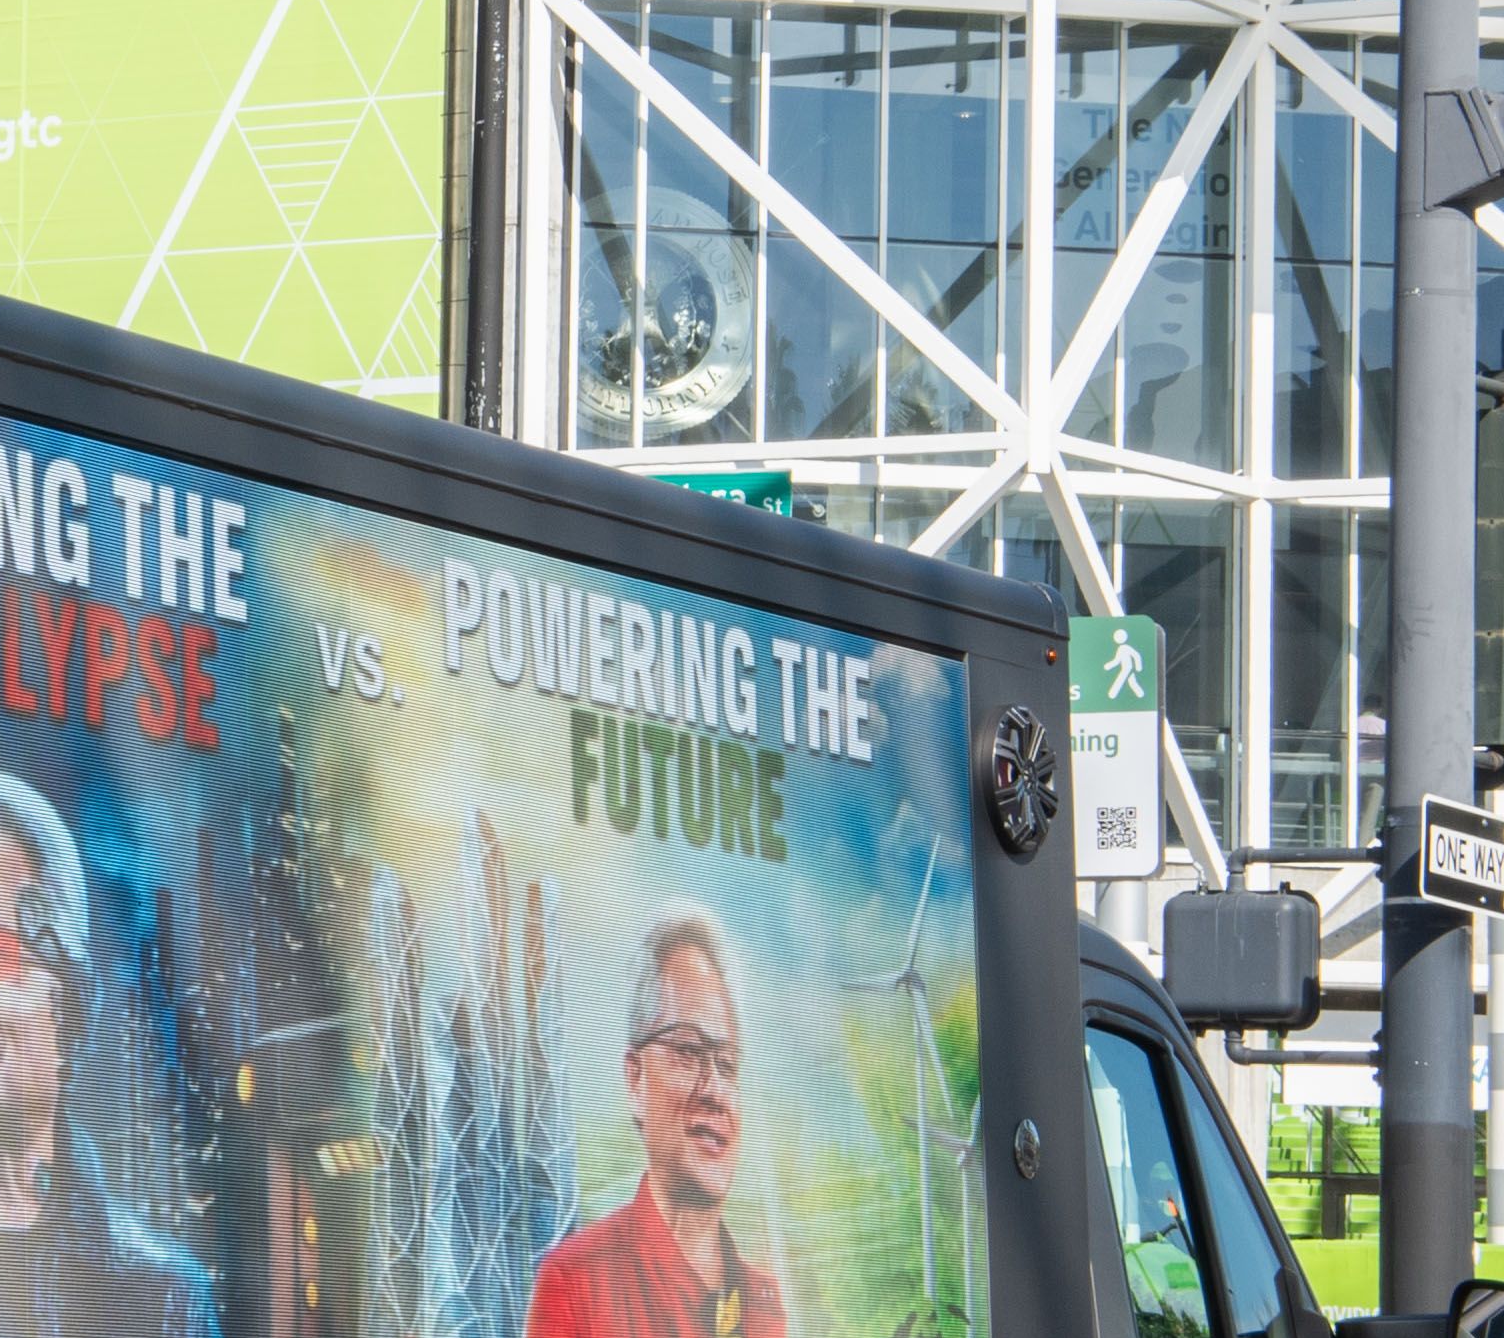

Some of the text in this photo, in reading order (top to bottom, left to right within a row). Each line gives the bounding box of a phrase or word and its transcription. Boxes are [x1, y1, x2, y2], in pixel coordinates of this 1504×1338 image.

[113, 473, 248, 623] THE
[441, 558, 873, 764] POWERING THE
[571, 709, 788, 862] FUTURE
[1436, 833, 1467, 875] ONE
